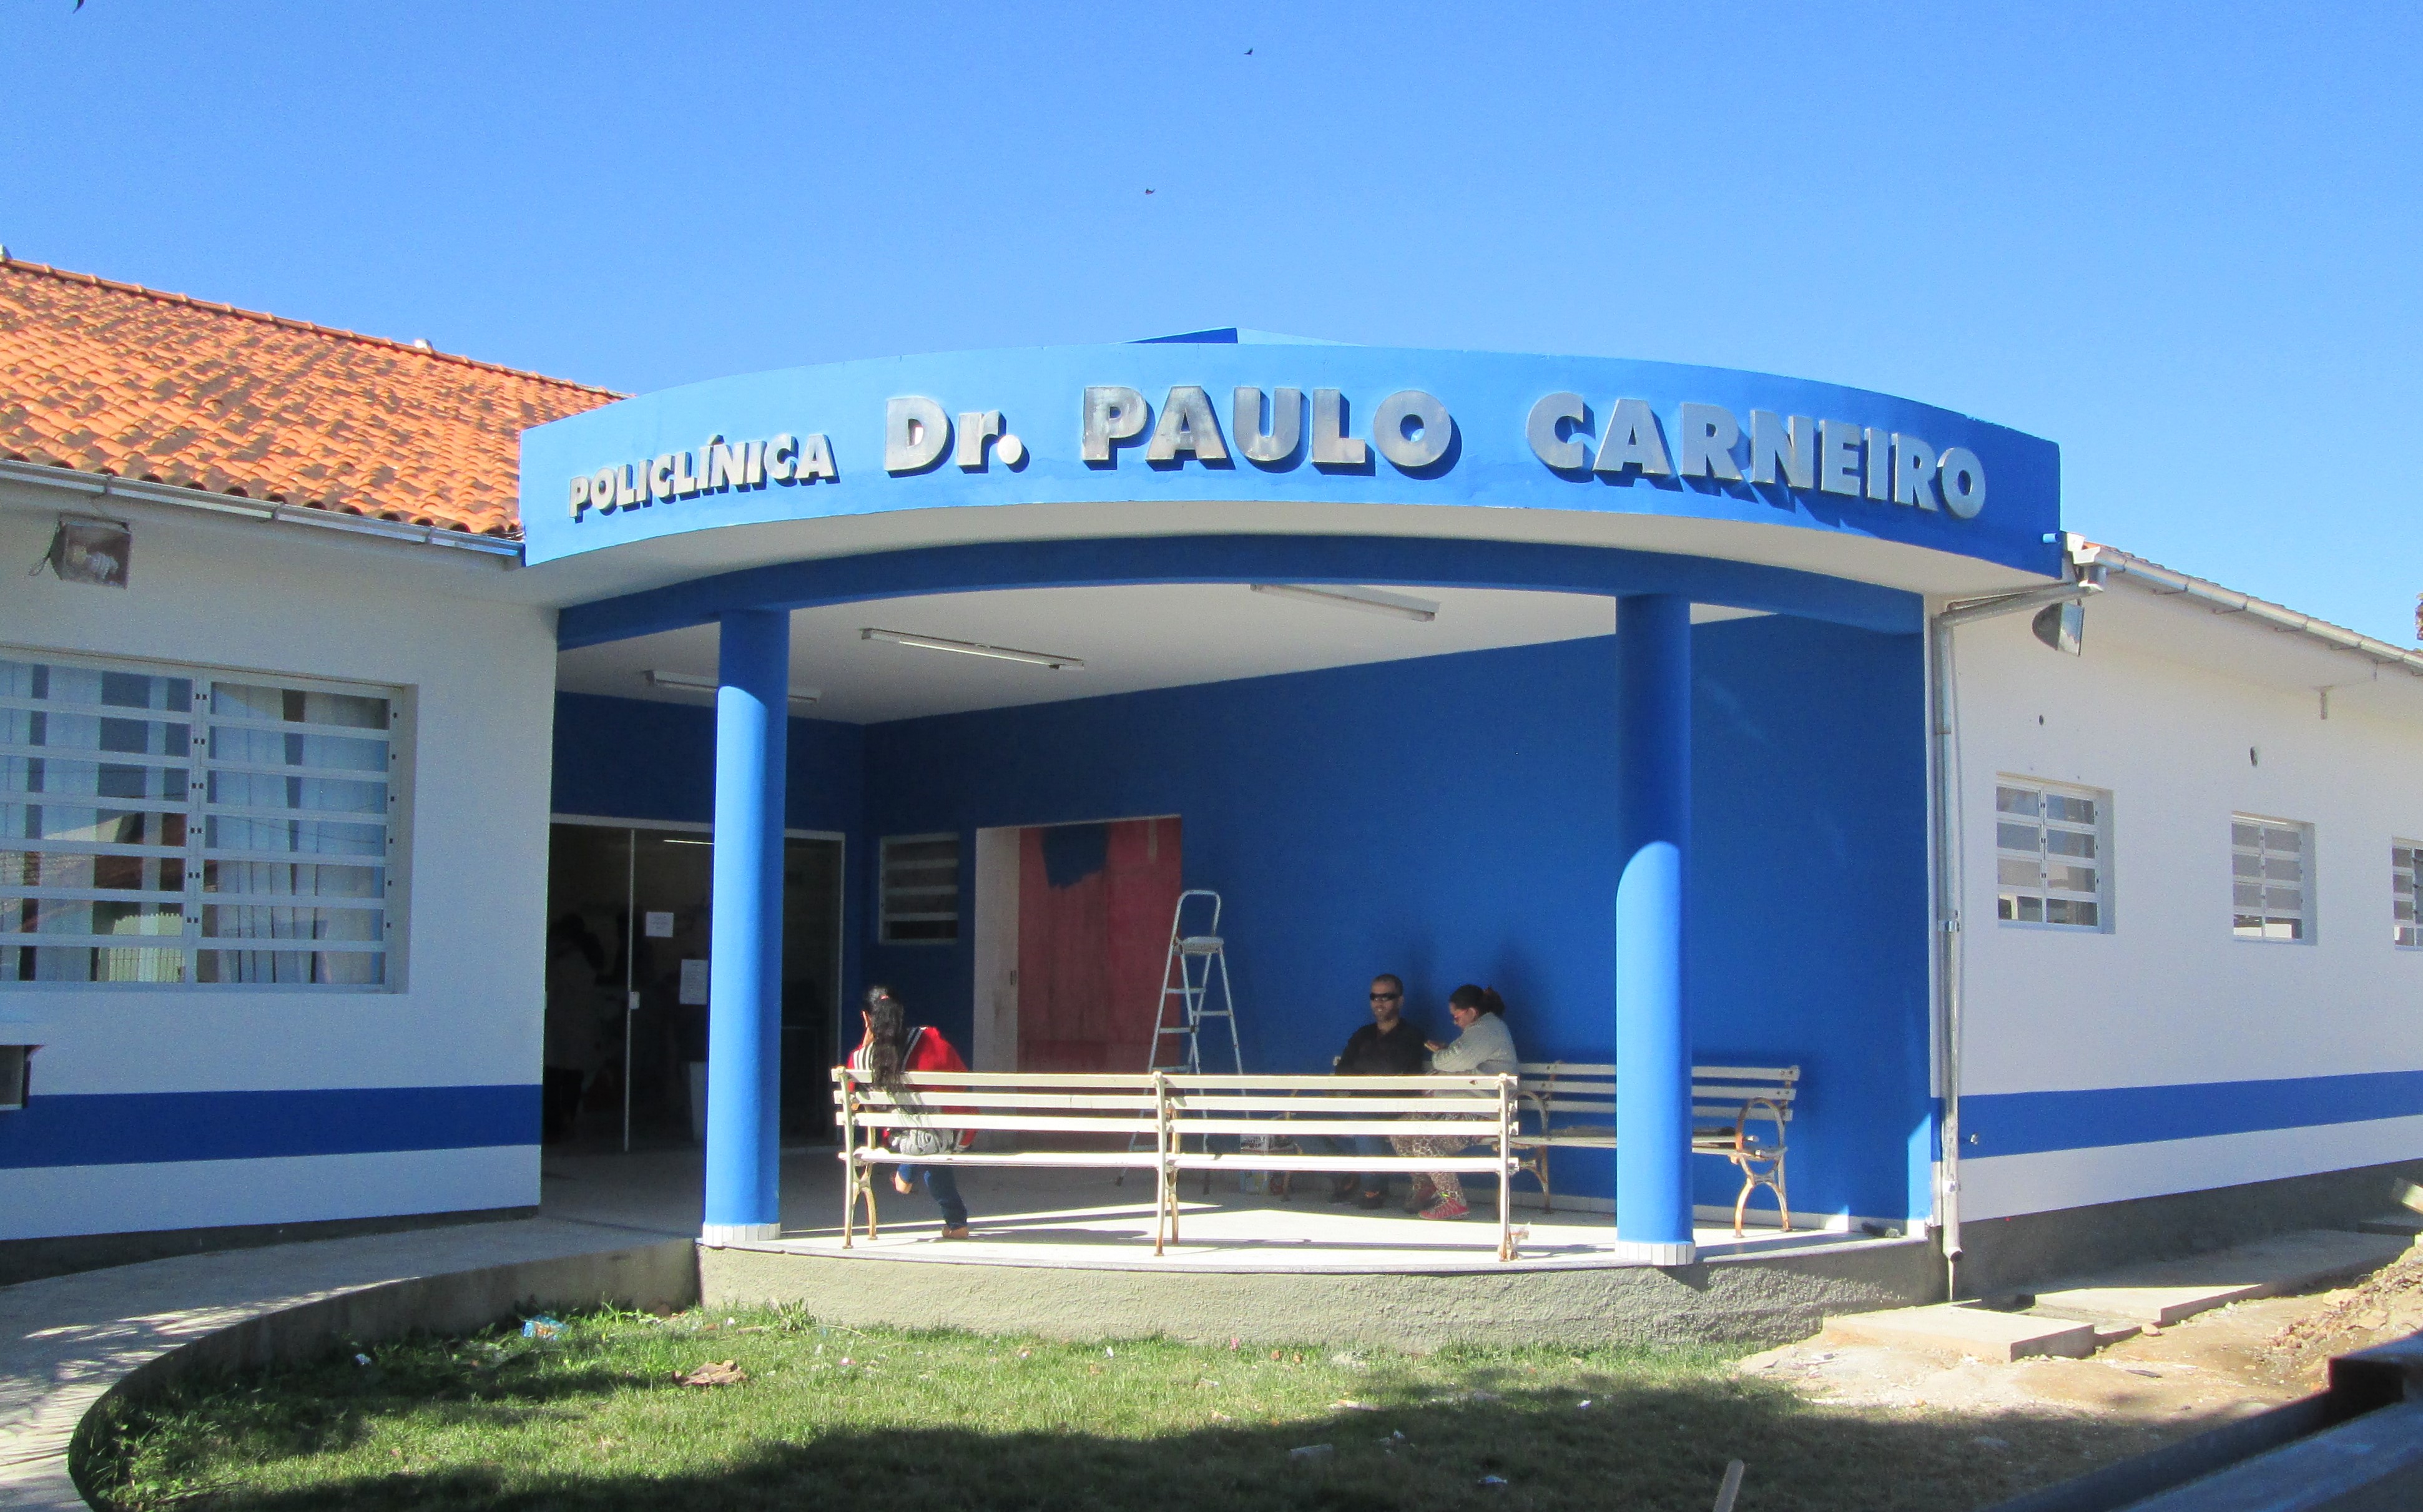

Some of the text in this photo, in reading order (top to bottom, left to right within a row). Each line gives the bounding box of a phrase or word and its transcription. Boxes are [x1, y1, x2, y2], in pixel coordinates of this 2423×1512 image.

[569, 385, 1987, 521] POLICLÍNICA Dr. PAULO CARNEIRO
